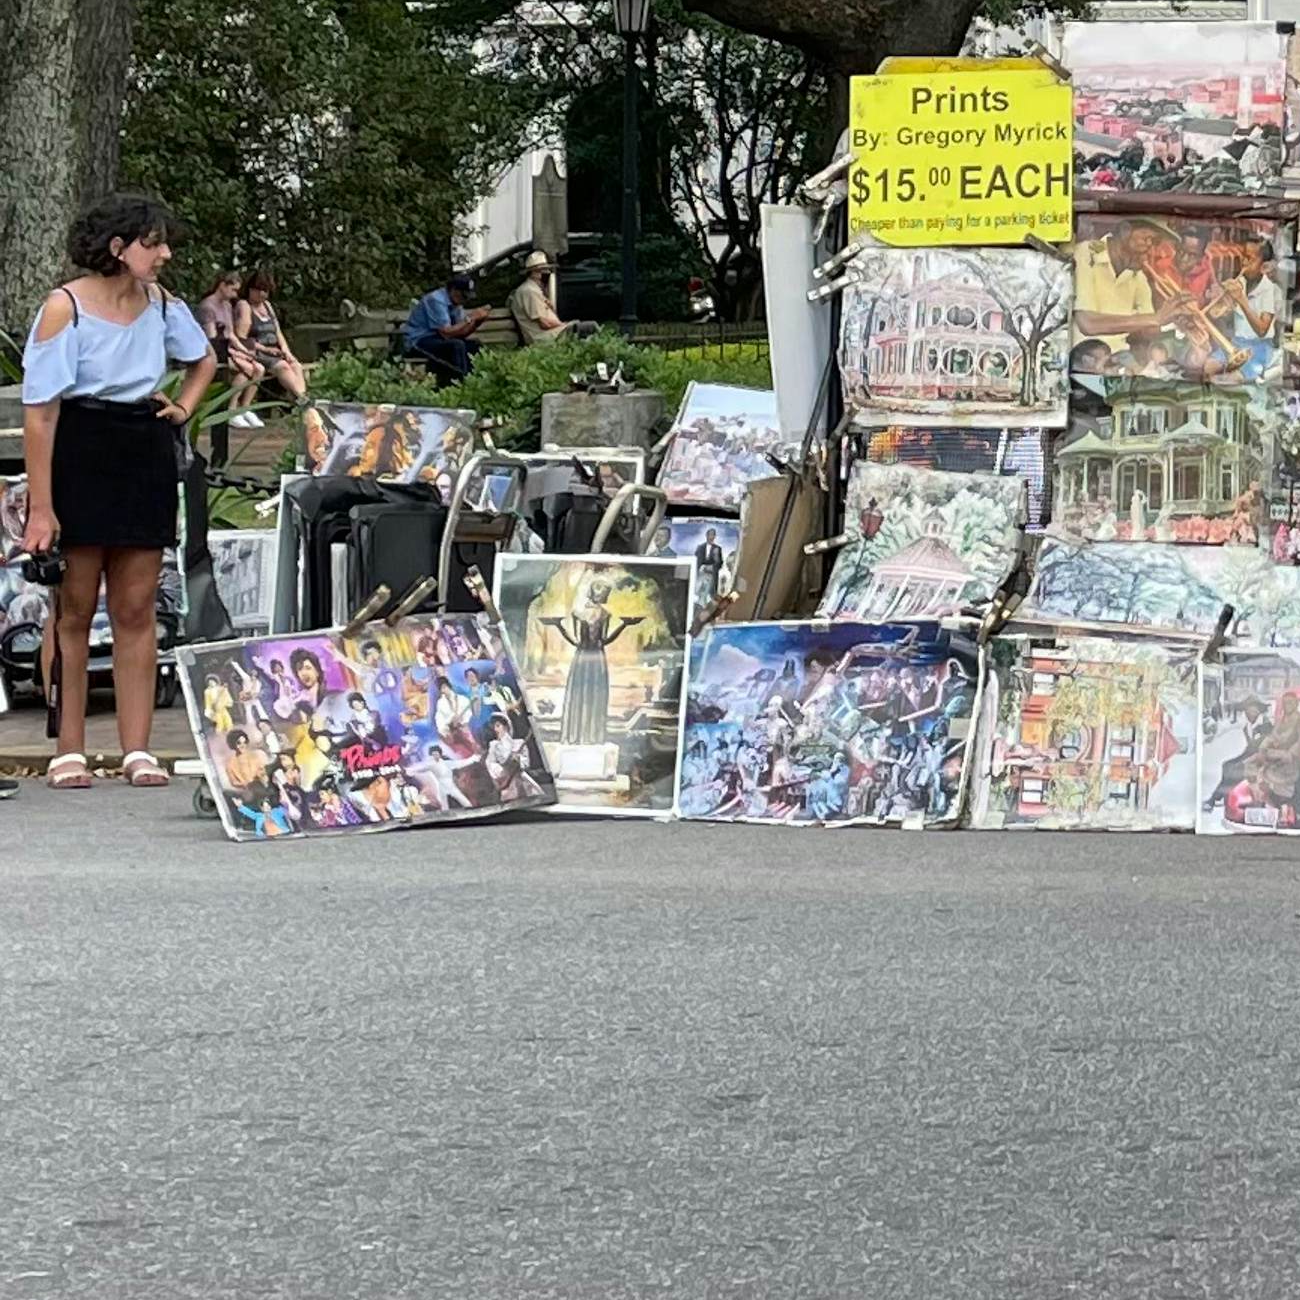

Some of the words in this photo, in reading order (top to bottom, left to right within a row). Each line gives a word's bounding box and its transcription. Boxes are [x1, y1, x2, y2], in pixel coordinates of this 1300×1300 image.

[911, 85, 1010, 115] Prints
[853, 129, 888, 151] By:
[896, 126, 987, 149] Gregory
[994, 121, 1068, 146] Myrick
[959, 162, 1070, 200] EACH
[850, 217, 896, 233] Cheaper
[898, 216, 924, 229] than
[926, 214, 963, 231] paying
[966, 212, 981, 228] for
[994, 211, 1035, 229] parking
[1038, 210, 1070, 225] ticket
